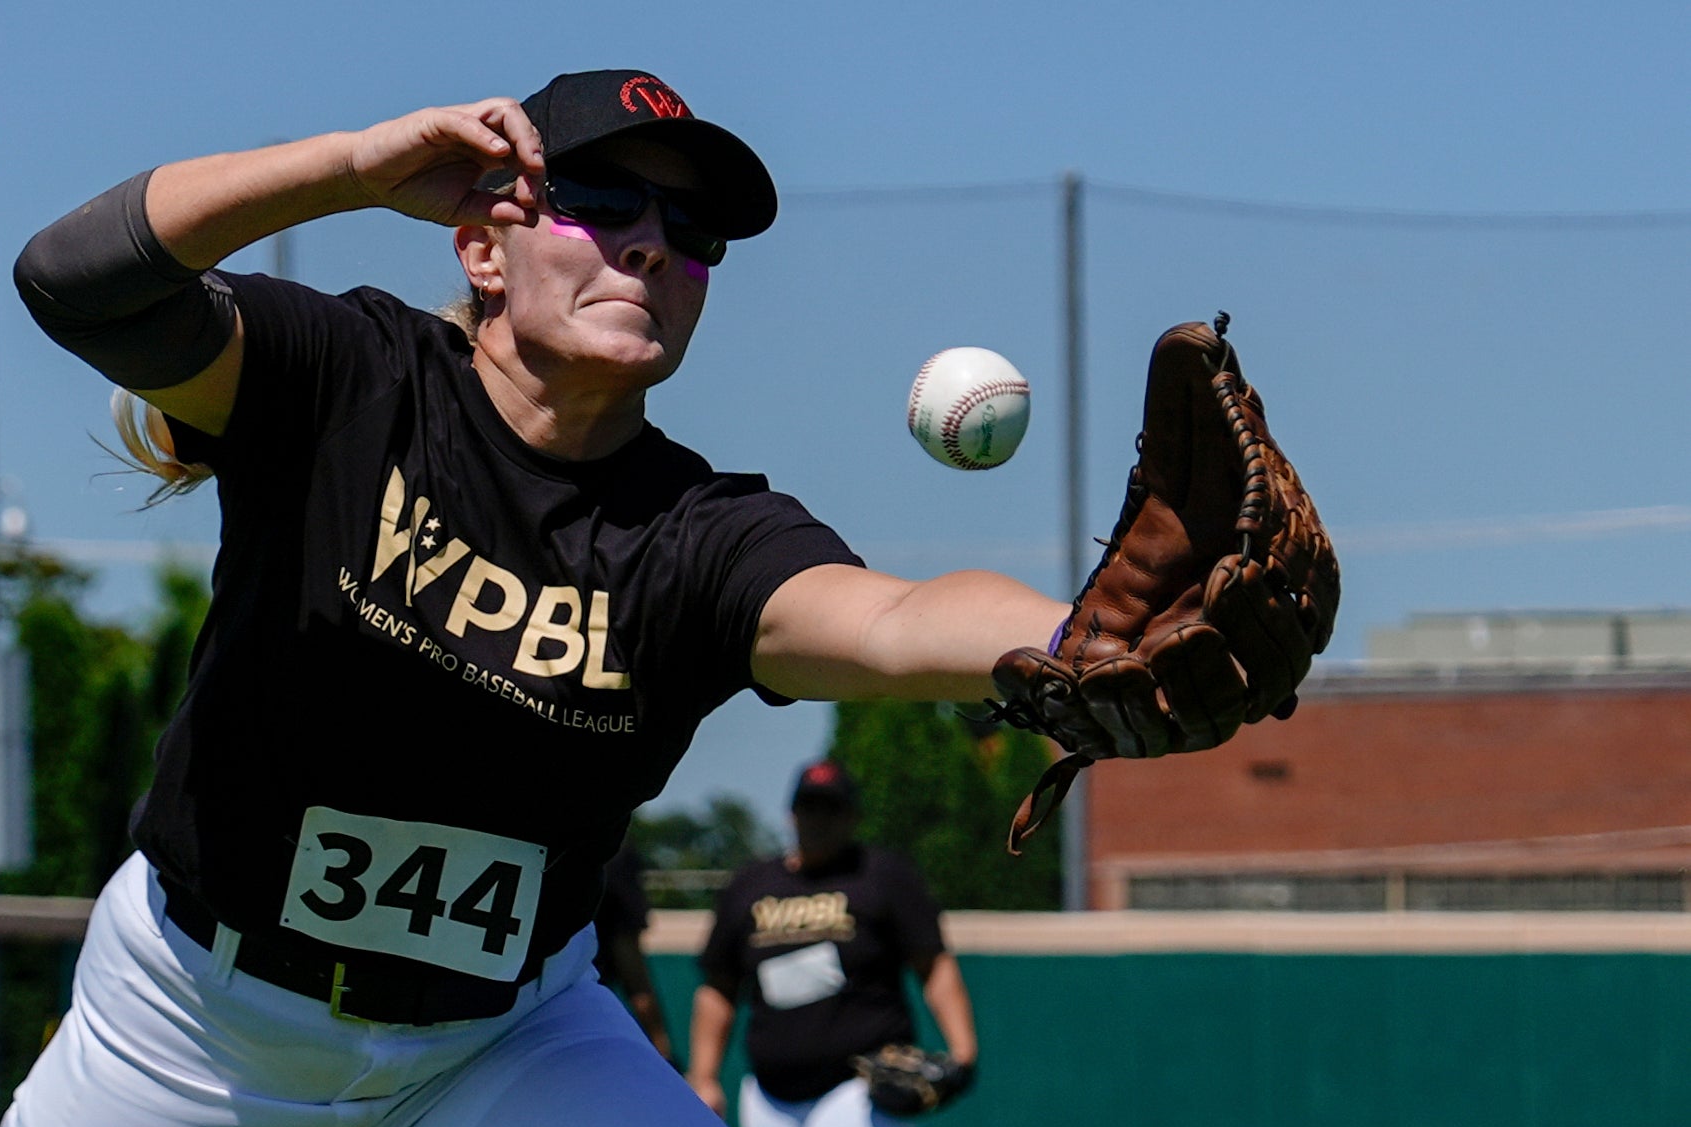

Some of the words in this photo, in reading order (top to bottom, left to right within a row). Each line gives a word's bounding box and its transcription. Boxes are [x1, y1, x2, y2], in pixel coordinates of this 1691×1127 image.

[371, 465, 631, 689] WPBL
[419, 636, 458, 671] PRO
[462, 662, 558, 723] BASEBALL
[563, 708, 635, 733] LEAGUE
[299, 832, 523, 956] 344
